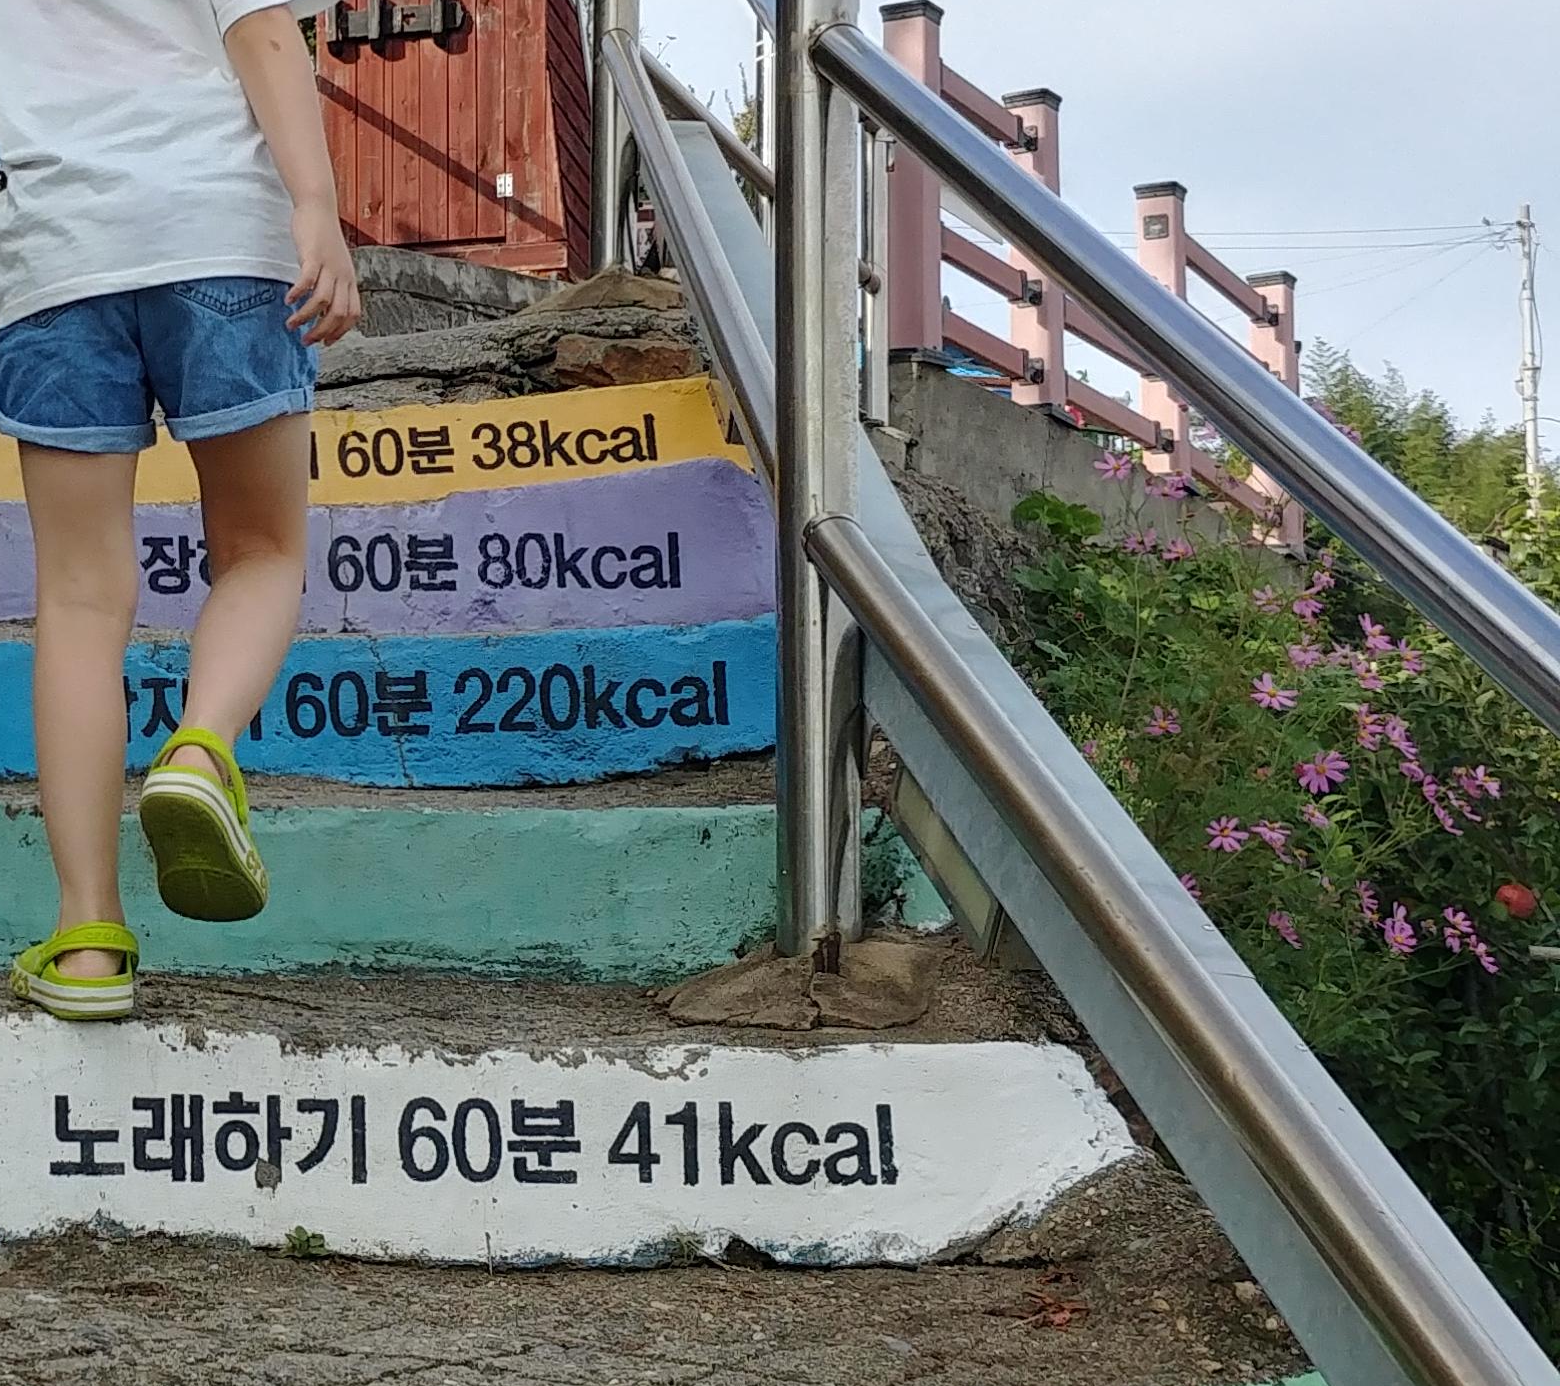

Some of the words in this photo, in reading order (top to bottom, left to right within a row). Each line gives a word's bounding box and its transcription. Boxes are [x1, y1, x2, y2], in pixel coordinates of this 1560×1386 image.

[338, 425, 455, 477] 60분
[471, 413, 658, 470] 38kcal
[327, 532, 459, 593] 60분
[477, 531, 682, 591] 80kcal
[285, 669, 433, 739] 60분
[452, 660, 731, 740] 220kcal
[49, 1091, 367, 1186] 노래하기
[397, 1096, 582, 1185] 60분
[607, 1101, 899, 1187] 41kcal
